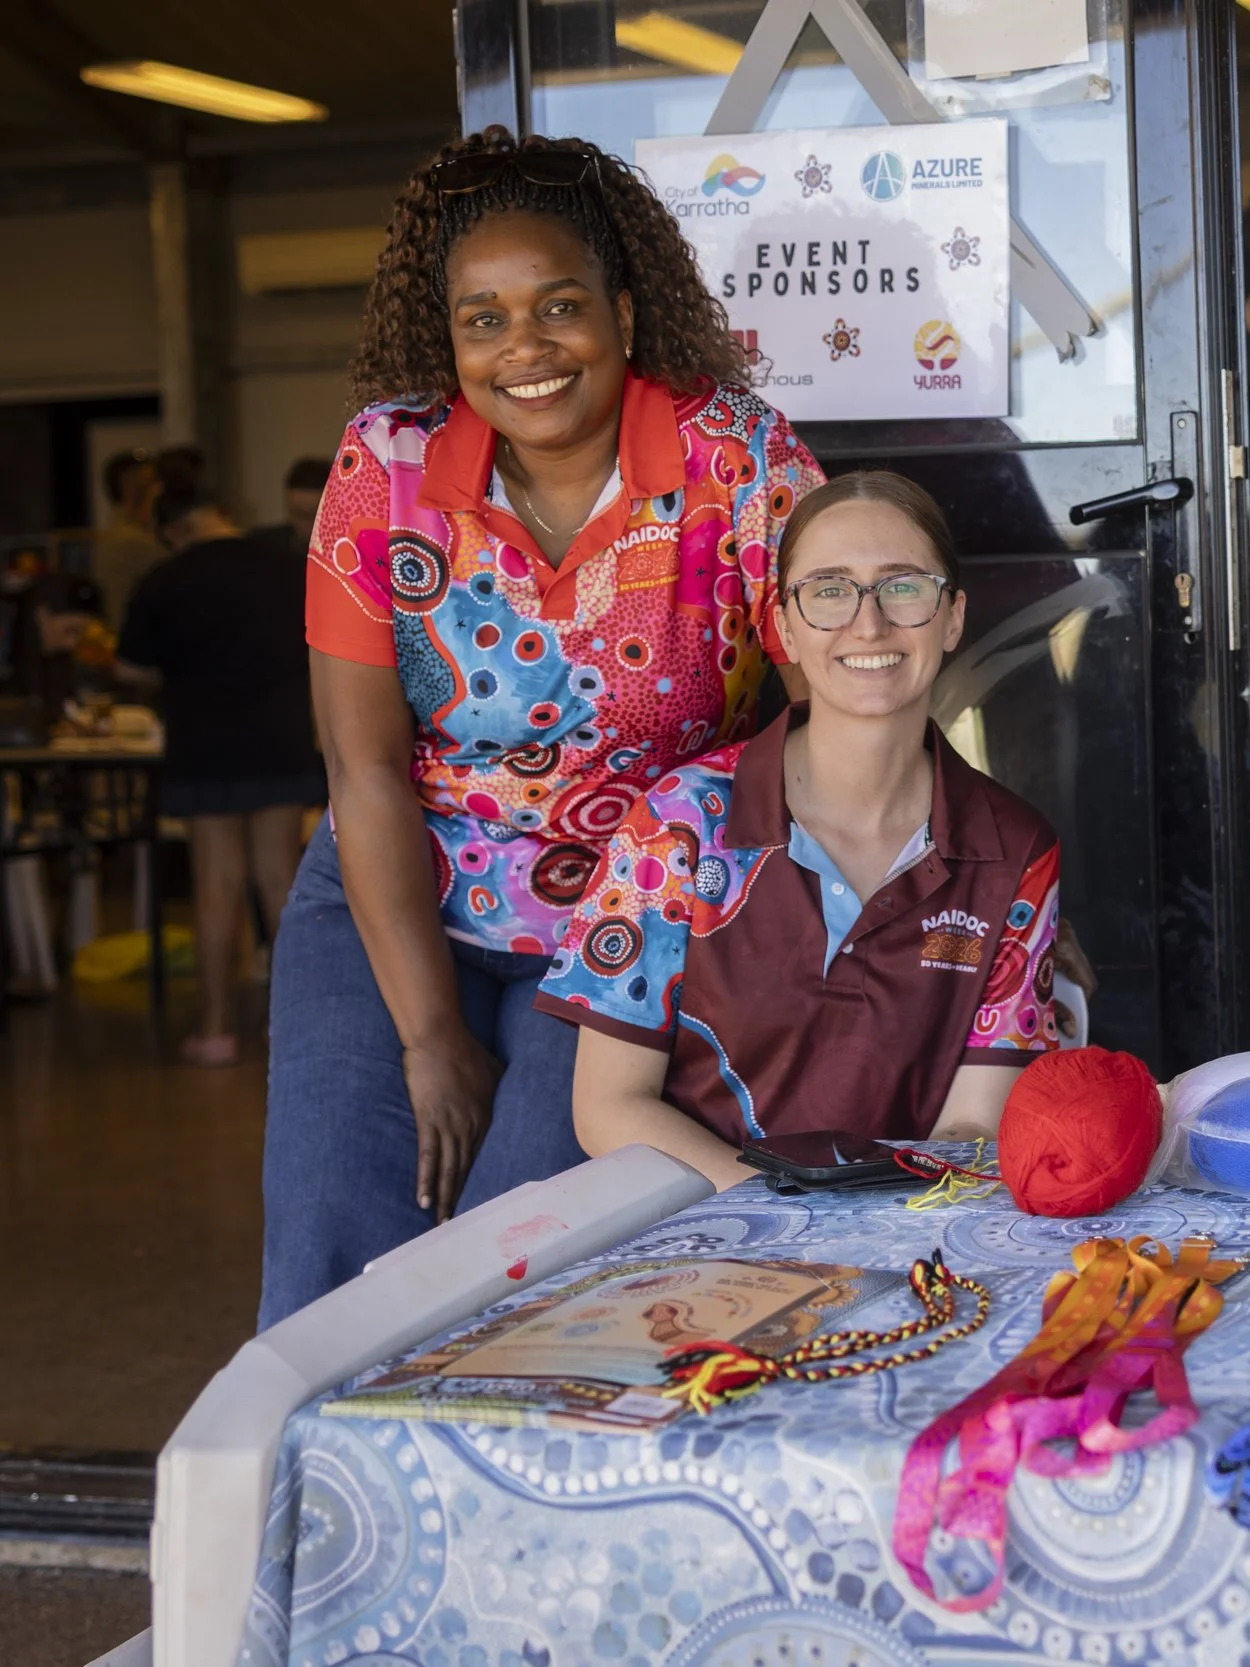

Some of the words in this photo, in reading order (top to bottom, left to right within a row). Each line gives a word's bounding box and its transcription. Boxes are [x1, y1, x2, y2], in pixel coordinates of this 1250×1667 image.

[912, 158, 983, 178] AZURE
[687, 185, 699, 197] of
[911, 180, 950, 190] MINERALS
[951, 179, 983, 189] LIMITED
[665, 197, 750, 218] Karratha
[756, 240, 870, 268] EVENT
[722, 267, 920, 298] SPONSORS
[914, 375, 962, 389] YURRA
[613, 525, 681, 554] NAIDOC
[921, 909, 989, 937] NAIDOC
[921, 933, 982, 964] 2026
